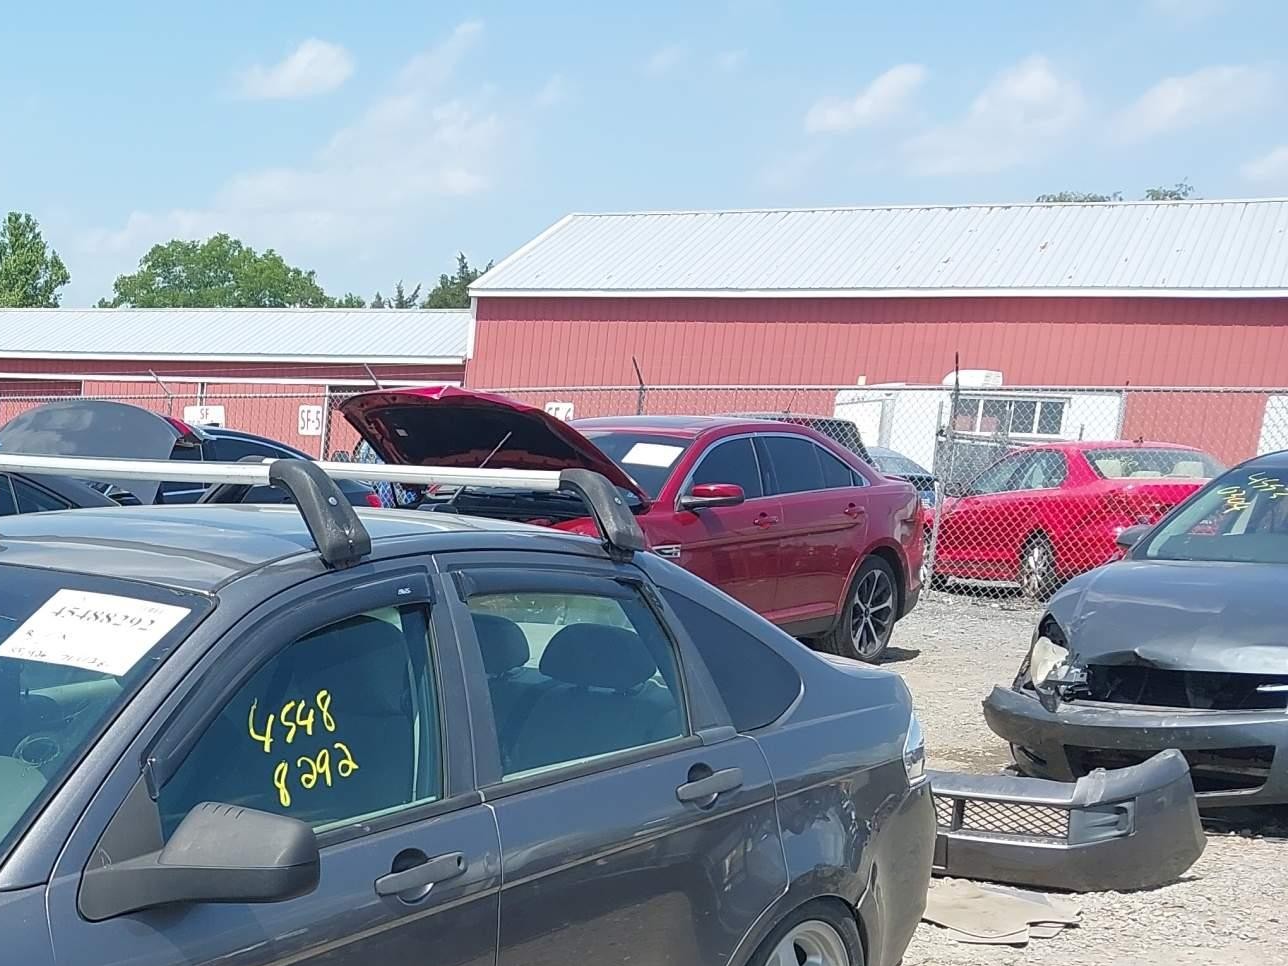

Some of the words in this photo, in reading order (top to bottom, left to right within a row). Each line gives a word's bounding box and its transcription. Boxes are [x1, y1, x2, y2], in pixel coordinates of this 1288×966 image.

[199, 407, 210, 420] SF
[300, 409, 320, 430] SF-5
[51, 605, 156, 631] 45488292
[247, 688, 337, 754] 4548
[273, 742, 360, 807] 8292
